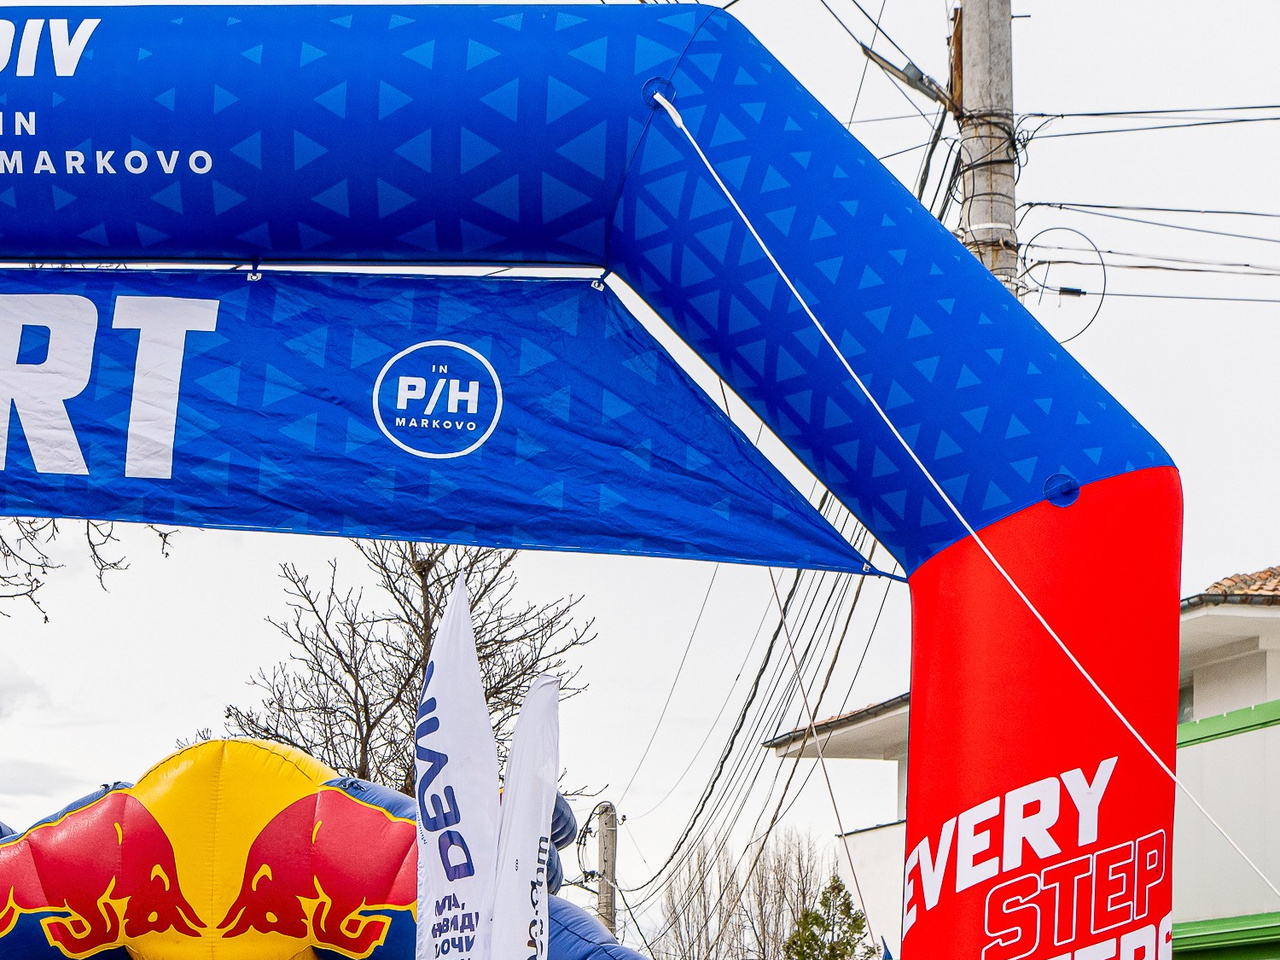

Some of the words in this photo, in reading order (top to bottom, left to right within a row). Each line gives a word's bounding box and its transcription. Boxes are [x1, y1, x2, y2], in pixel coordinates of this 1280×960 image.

[431, 364, 448, 374] IN
[396, 376, 479, 415] P/H
[395, 417, 477, 431] MARKOVO
[902, 756, 1120, 942] EVERY
